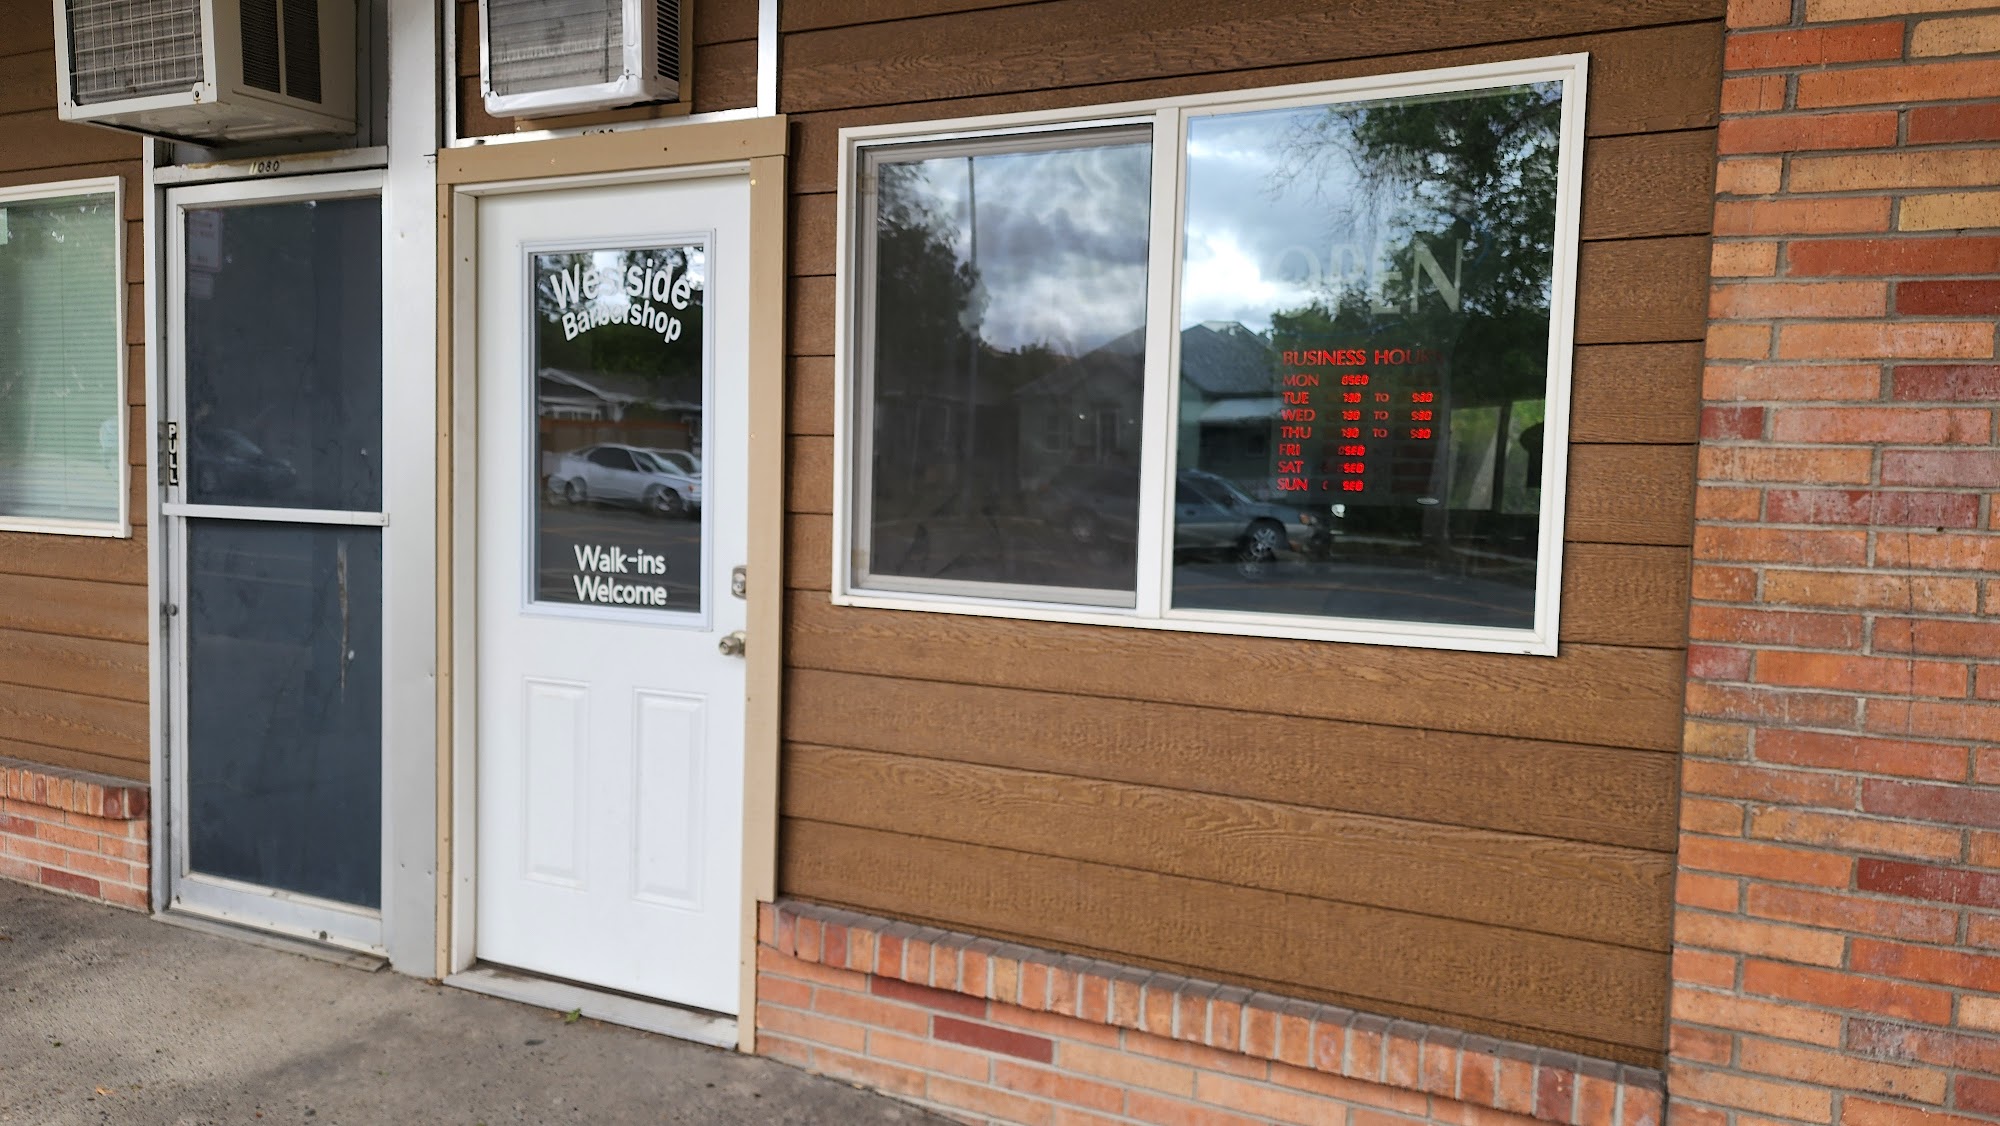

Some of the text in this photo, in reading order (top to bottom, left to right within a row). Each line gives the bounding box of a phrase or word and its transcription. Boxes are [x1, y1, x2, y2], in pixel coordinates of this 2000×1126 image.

[250, 160, 280, 174] 1080
[550, 258, 691, 310] Westside
[1273, 238, 1463, 319] OPEN
[562, 300, 682, 343] Barbershop
[1283, 350, 1367, 366] BUSINESS
[1283, 374, 1319, 386] MON
[1282, 391, 1310, 404] TUE
[1375, 393, 1390, 402] TO
[1281, 409, 1316, 421] WED
[1374, 411, 1389, 420] TO
[1280, 426, 1312, 439] THU
[1373, 429, 1388, 438] TO
[168, 424, 177, 483] PULL
[1279, 443, 1301, 456] FRI
[1278, 461, 1304, 473] SAT
[1277, 478, 1308, 491] SUN
[574, 544, 666, 575] Walk-ins
[573, 574, 667, 606] Welcome
